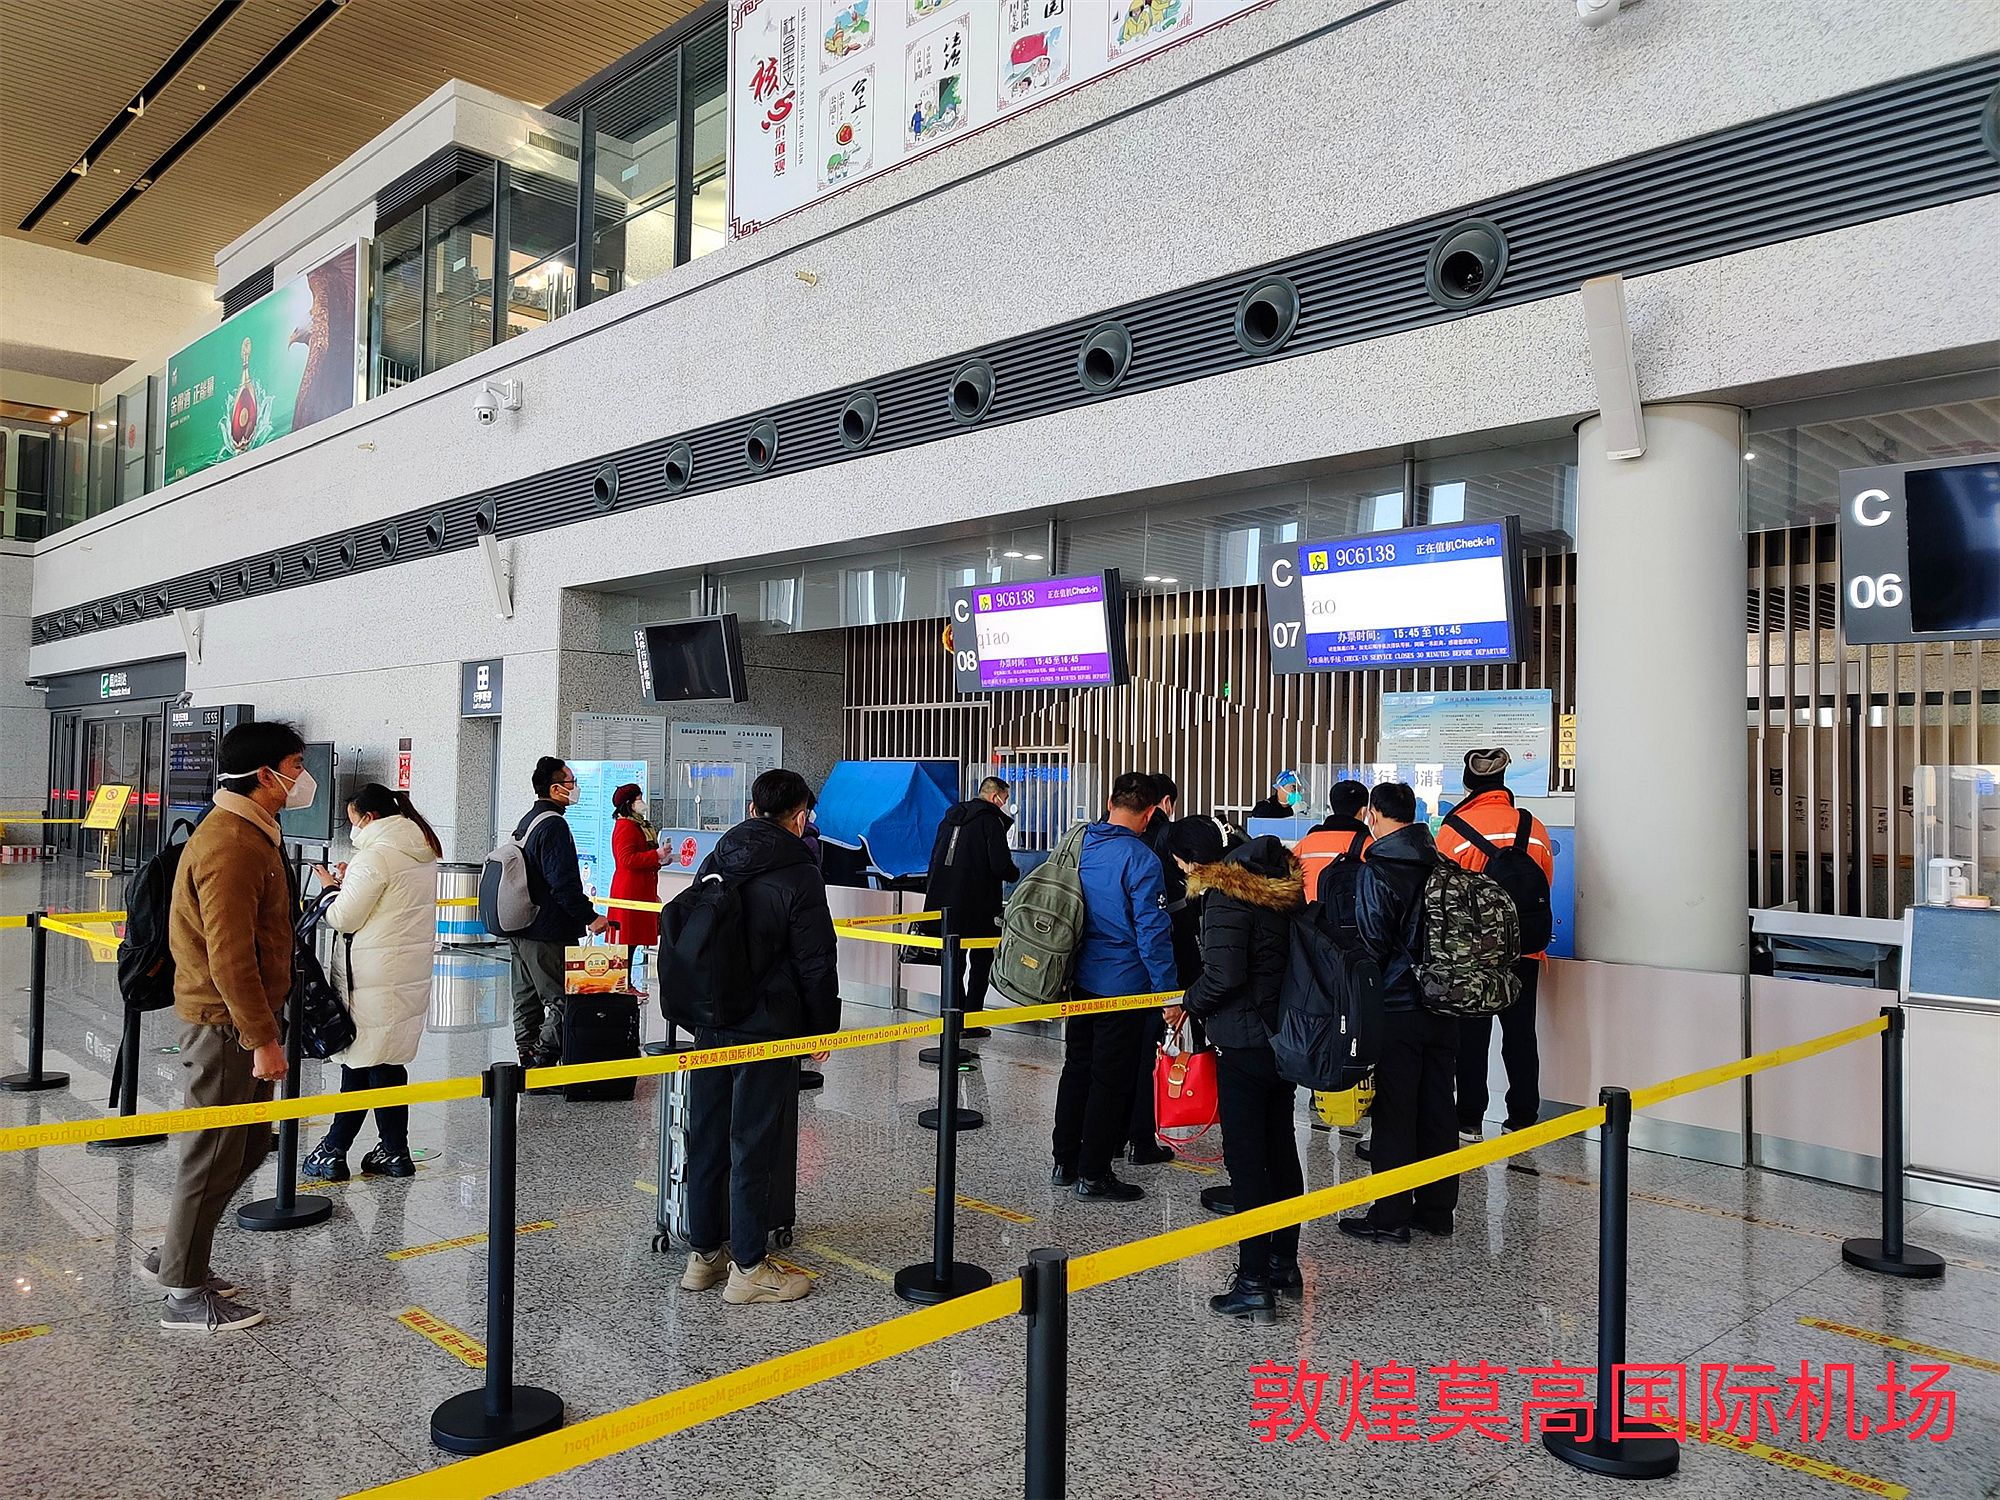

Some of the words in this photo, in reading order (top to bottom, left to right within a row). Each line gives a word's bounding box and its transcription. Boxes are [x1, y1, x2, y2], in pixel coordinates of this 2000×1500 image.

[783, 15, 796, 91] 社会主义
[943, 31, 962, 71] 法治
[851, 78, 867, 114] 公正
[774, 123, 786, 179] 价值观
[1853, 488, 1892, 527] C
[1335, 543, 1396, 567] 9C6138
[1271, 558, 1294, 587] C
[996, 589, 1035, 608] 9C6138
[1848, 573, 1904, 609] 06
[954, 599, 970, 623] C
[1272, 621, 1301, 648] 07
[1393, 626, 1420, 639] 15:45
[1422, 626, 1433, 638] 至
[1434, 624, 1462, 637] 16:45
[956, 650, 978, 671] 08
[1035, 656, 1053, 666] 15:45
[1121, 996, 1153, 1007] Dunhuang
[690, 1045, 765, 1067] 敦煌莫高国际机场
[772, 1038, 817, 1055] Dunhuang
[819, 1035, 849, 1050] Mogao
[850, 1026, 901, 1043] International
[902, 1022, 931, 1038] Airport
[1767, 1450, 1891, 1493] 保持一米间距
